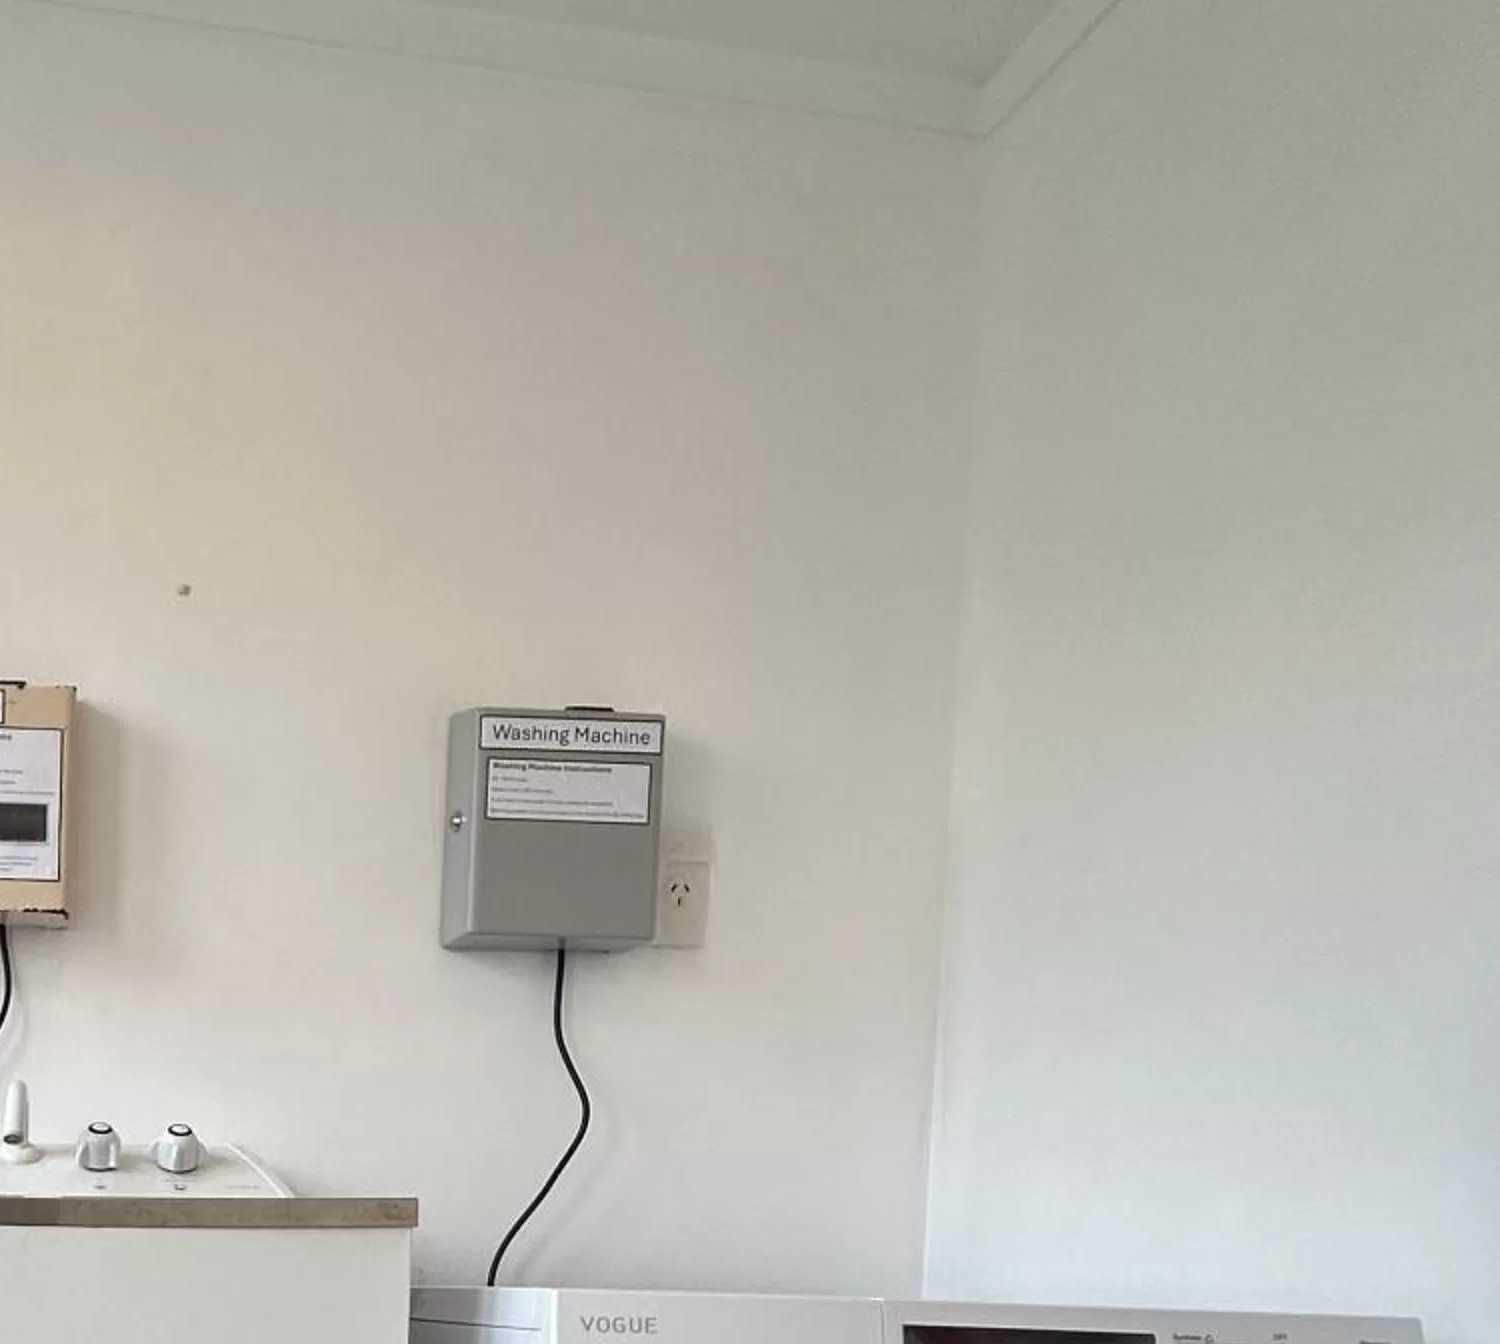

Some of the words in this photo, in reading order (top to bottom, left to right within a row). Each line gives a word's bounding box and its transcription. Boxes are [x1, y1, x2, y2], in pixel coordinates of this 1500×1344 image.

[493, 724, 570, 746] Washing
[574, 727, 652, 746] Machine
[580, 1316, 658, 1335] VOGUE
